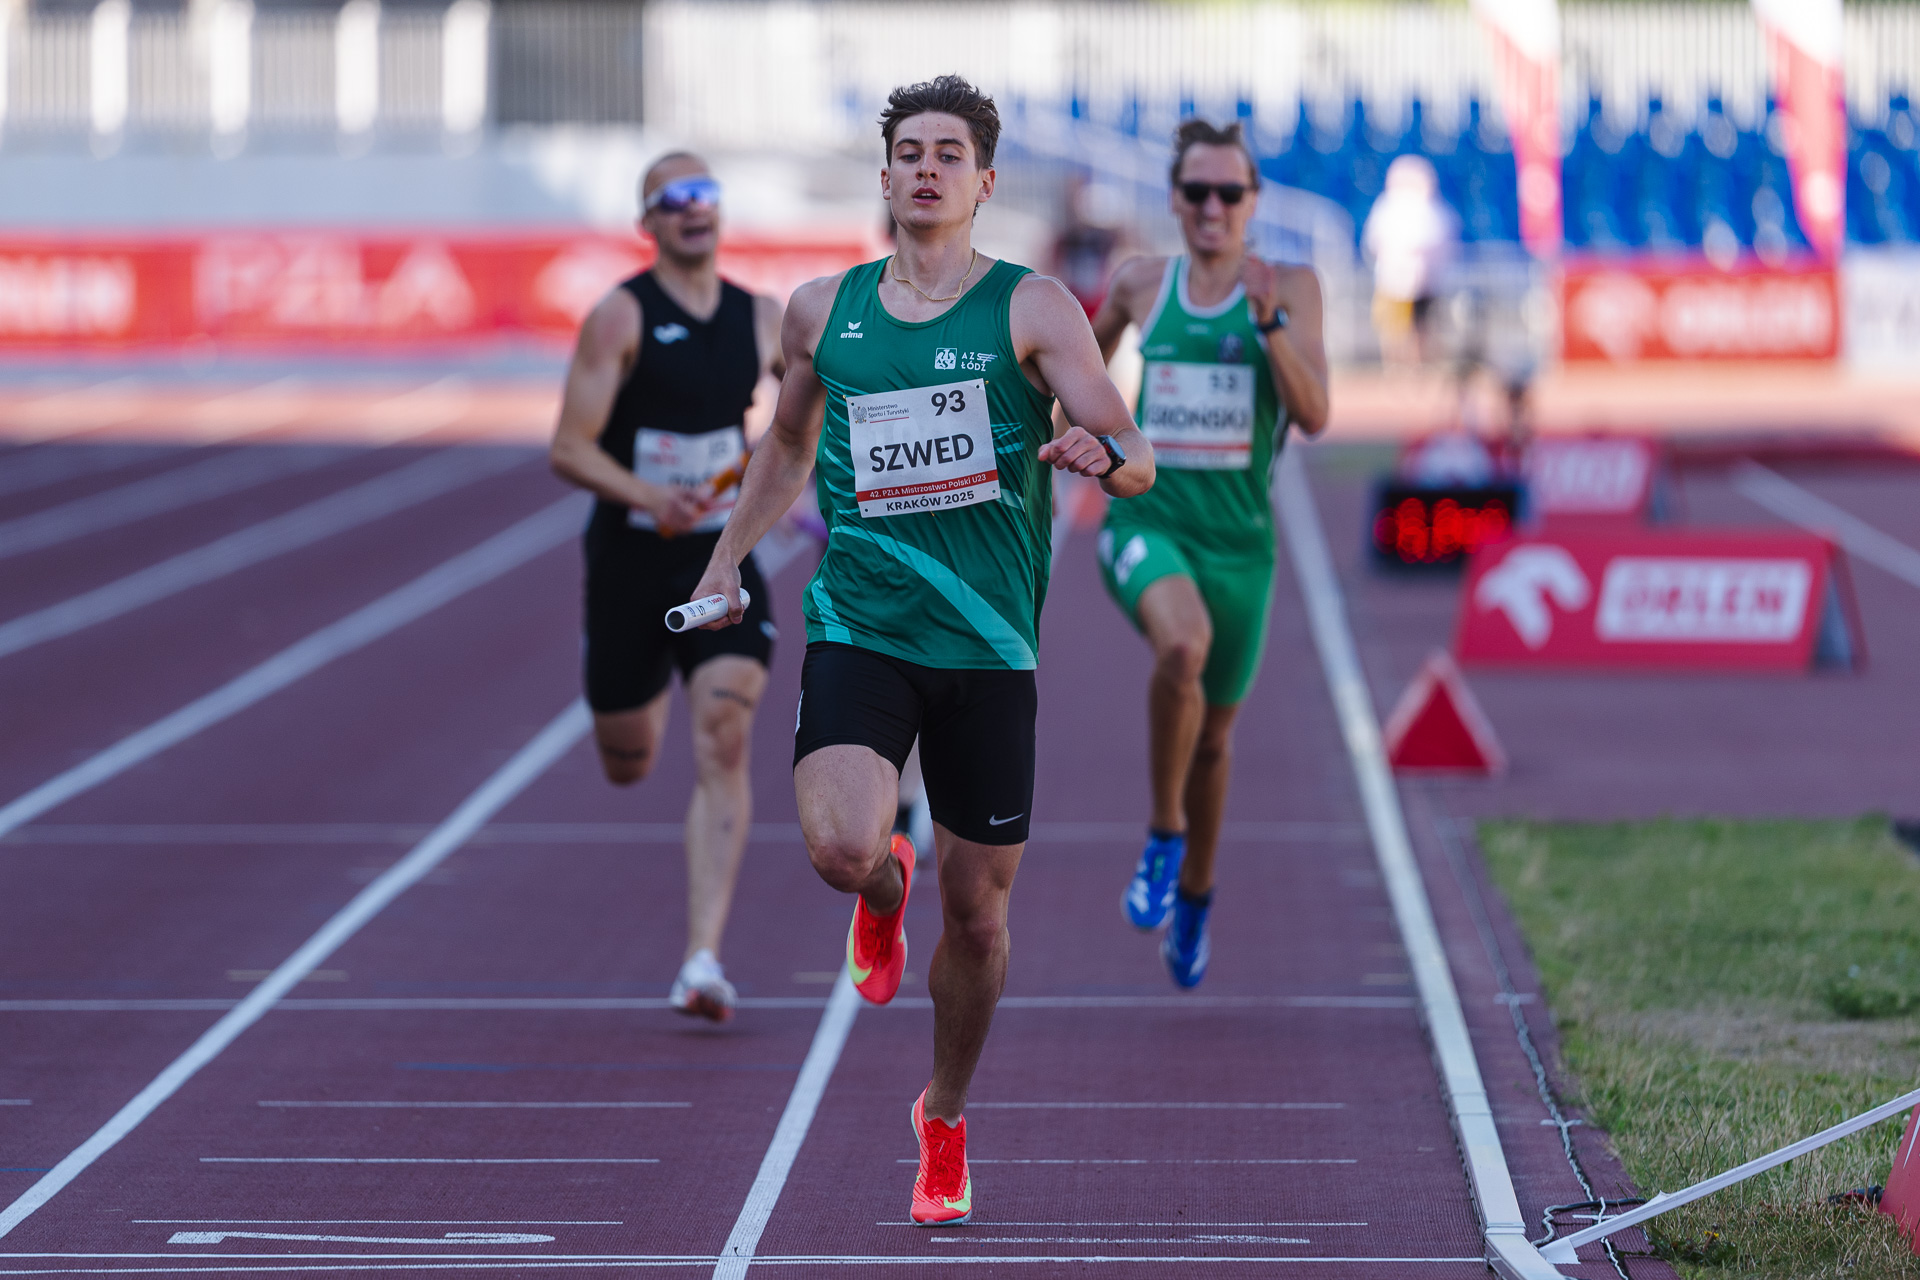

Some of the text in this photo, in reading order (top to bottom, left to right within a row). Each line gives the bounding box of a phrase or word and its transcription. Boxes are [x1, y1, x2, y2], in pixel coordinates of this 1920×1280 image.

[840, 331, 864, 339] erima
[867, 403, 898, 412] Ministerstwo
[931, 390, 966, 416] 93
[869, 433, 974, 473] SZWED
[882, 488, 900, 497] PZLA
[901, 483, 947, 495] Mistrzostwa
[948, 479, 971, 489] Polski
[971, 473, 987, 484] U23
[886, 490, 975, 511] KRAKÓW 2025
